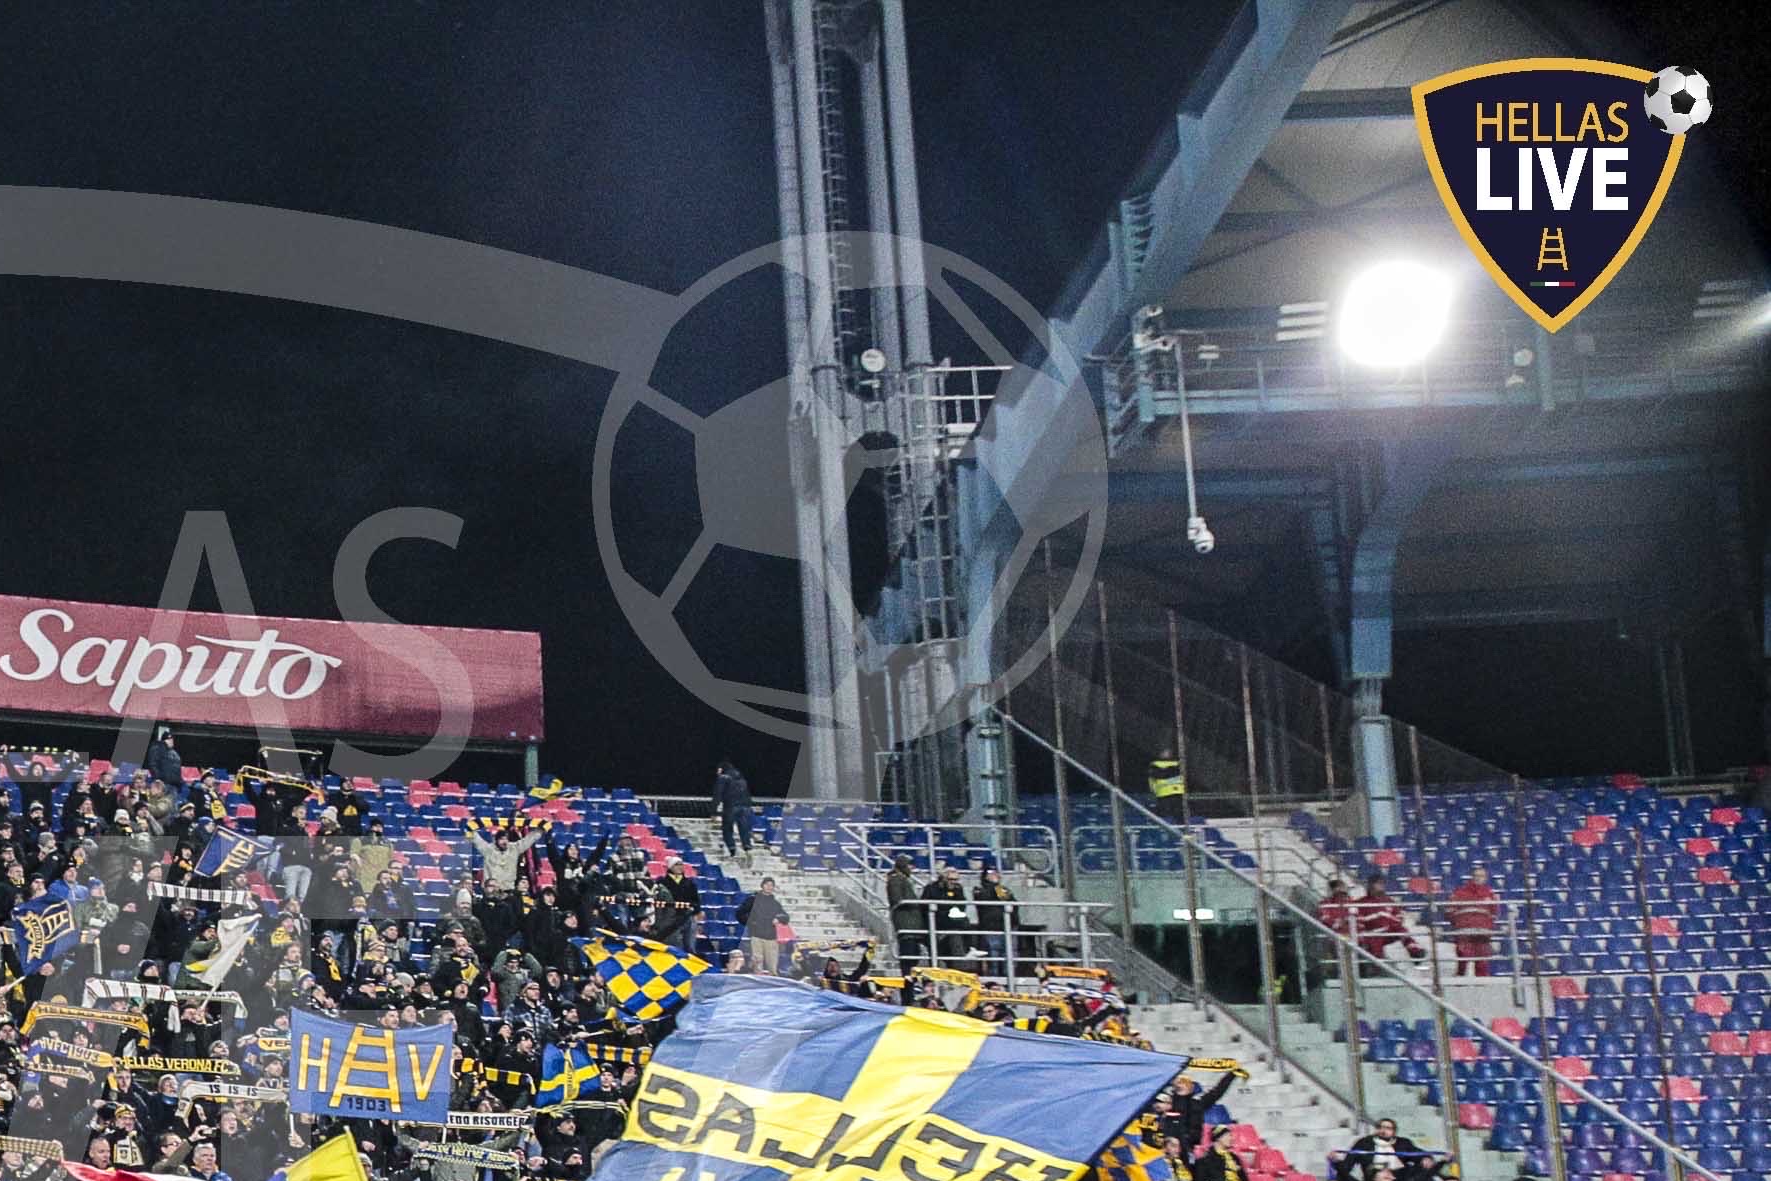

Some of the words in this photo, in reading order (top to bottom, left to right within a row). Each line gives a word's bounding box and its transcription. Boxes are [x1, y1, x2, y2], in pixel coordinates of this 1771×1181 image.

[0, 608, 342, 713] Saputo
[167, 1058, 213, 1073] VERONA
[347, 1098, 387, 1113] 1903
